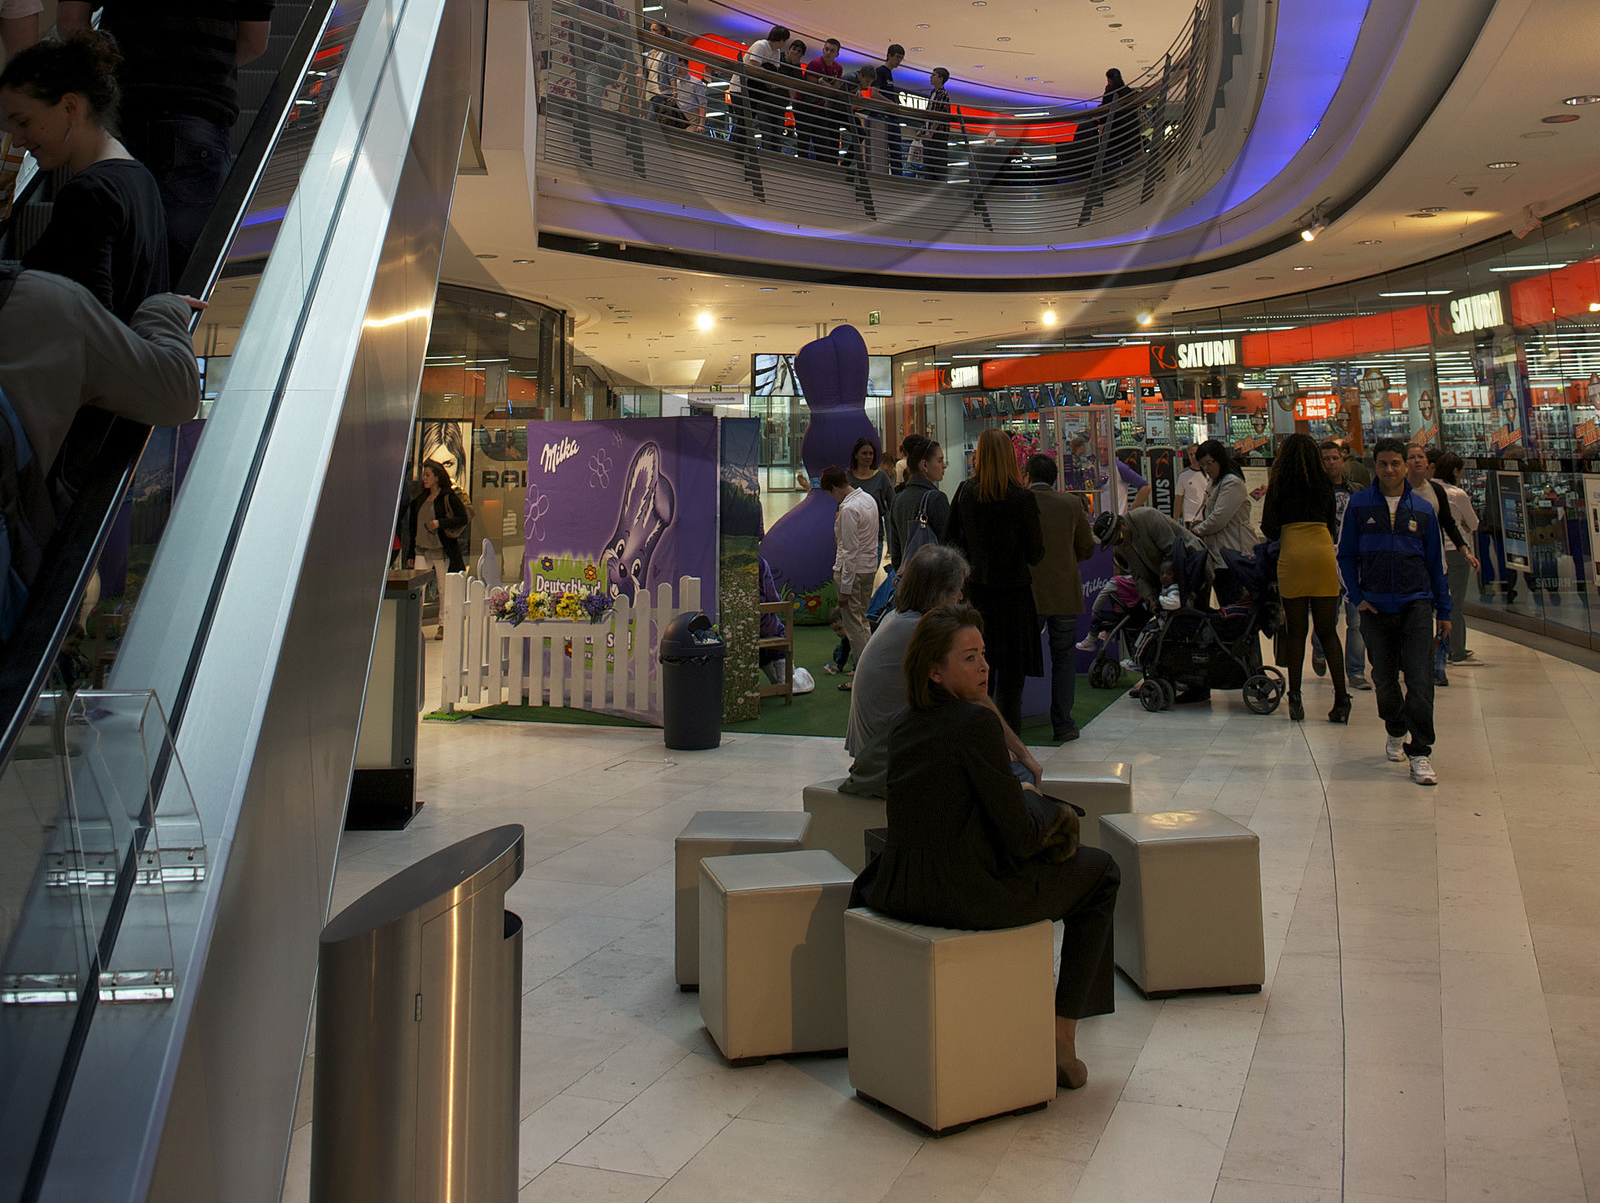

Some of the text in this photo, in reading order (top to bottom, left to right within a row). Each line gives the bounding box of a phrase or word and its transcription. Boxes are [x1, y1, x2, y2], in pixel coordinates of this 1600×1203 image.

[1450, 290, 1504, 335] SATURN
[1178, 339, 1236, 369] SATURN
[950, 365, 979, 388] SATURN
[1143, 388, 1150, 396] 2
[540, 436, 580, 474] Milka
[1156, 478, 1171, 517] SATU
[1535, 577, 1571, 588] SATURN
